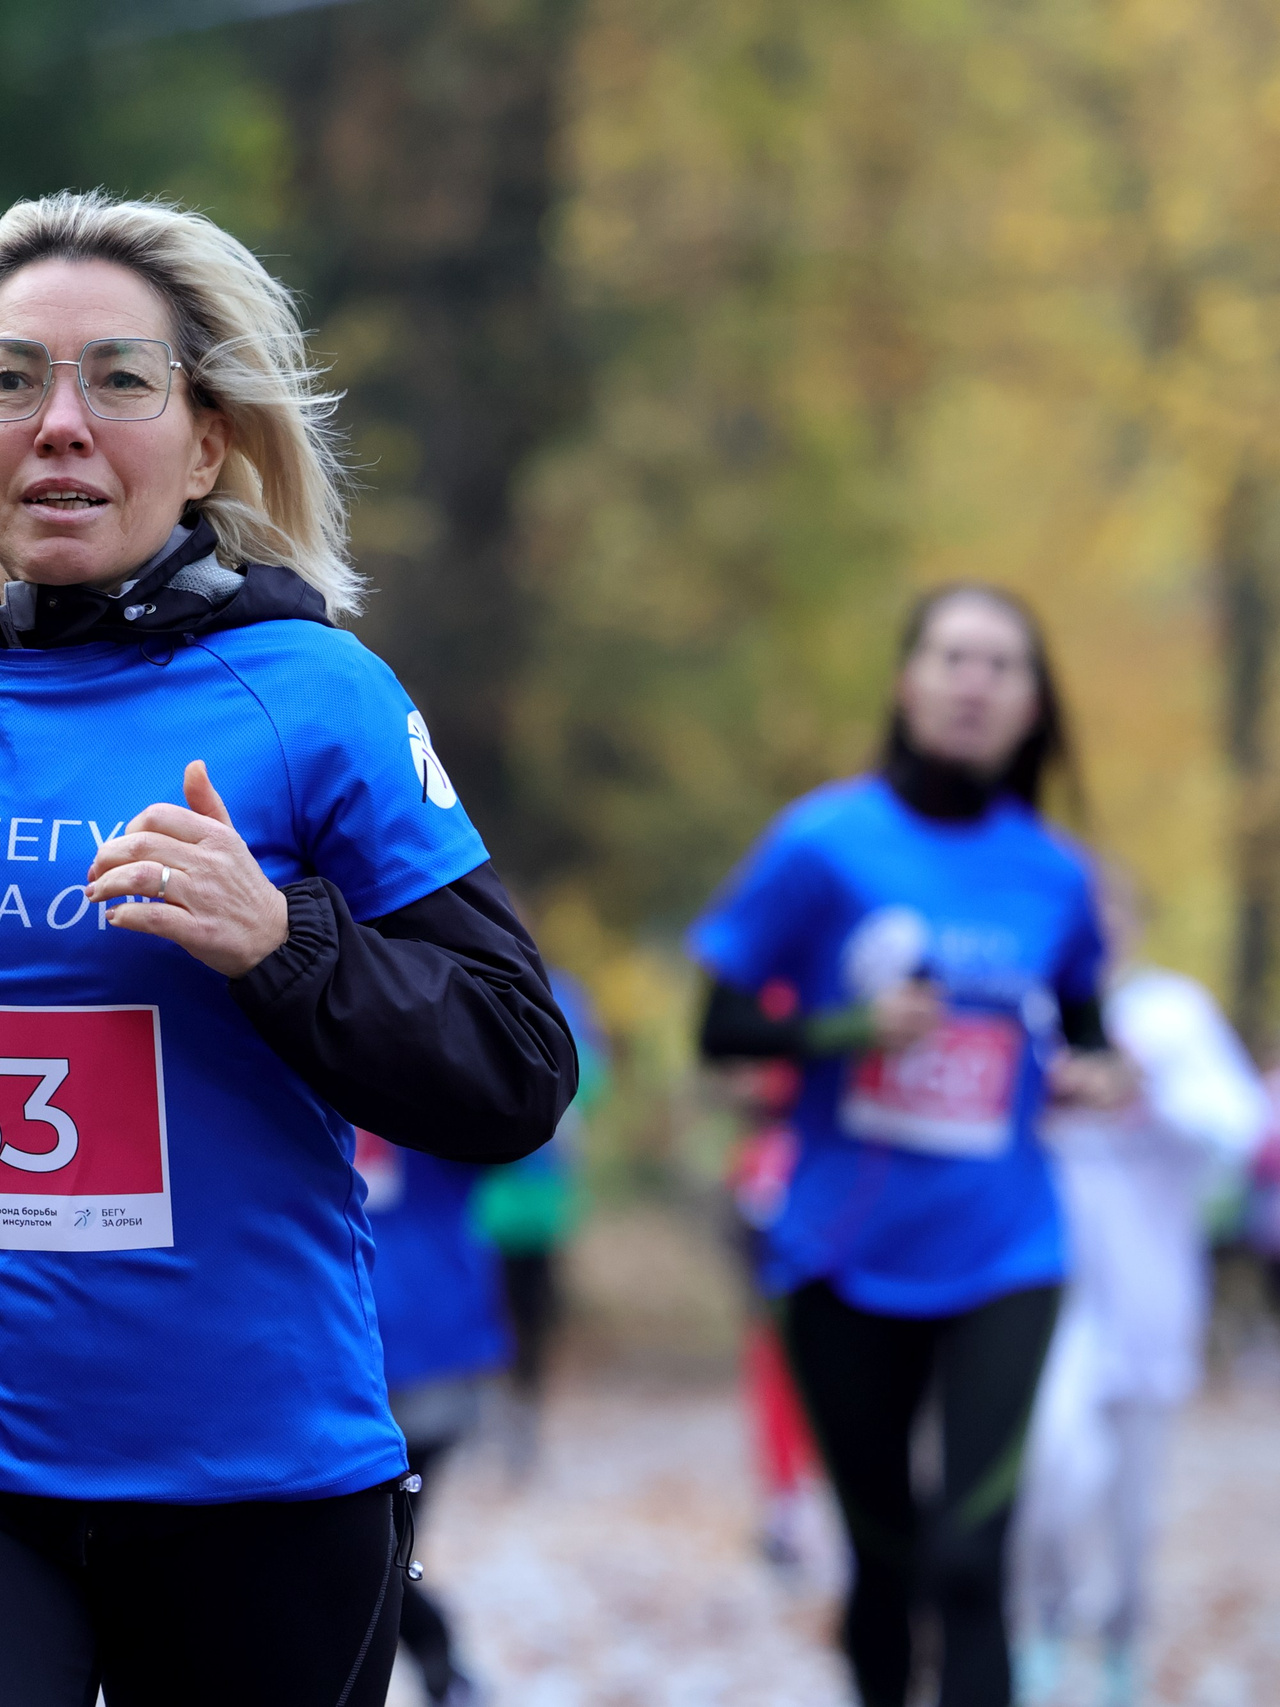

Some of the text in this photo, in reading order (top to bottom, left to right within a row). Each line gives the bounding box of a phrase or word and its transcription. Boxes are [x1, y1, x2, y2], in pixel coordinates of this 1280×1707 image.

[21, 1206, 58, 1217] борьбы
[101, 1208, 126, 1217] БЕГУ
[2, 1218, 52, 1228] инсультом
[101, 1217, 143, 1228] ЗА ОРБИ
